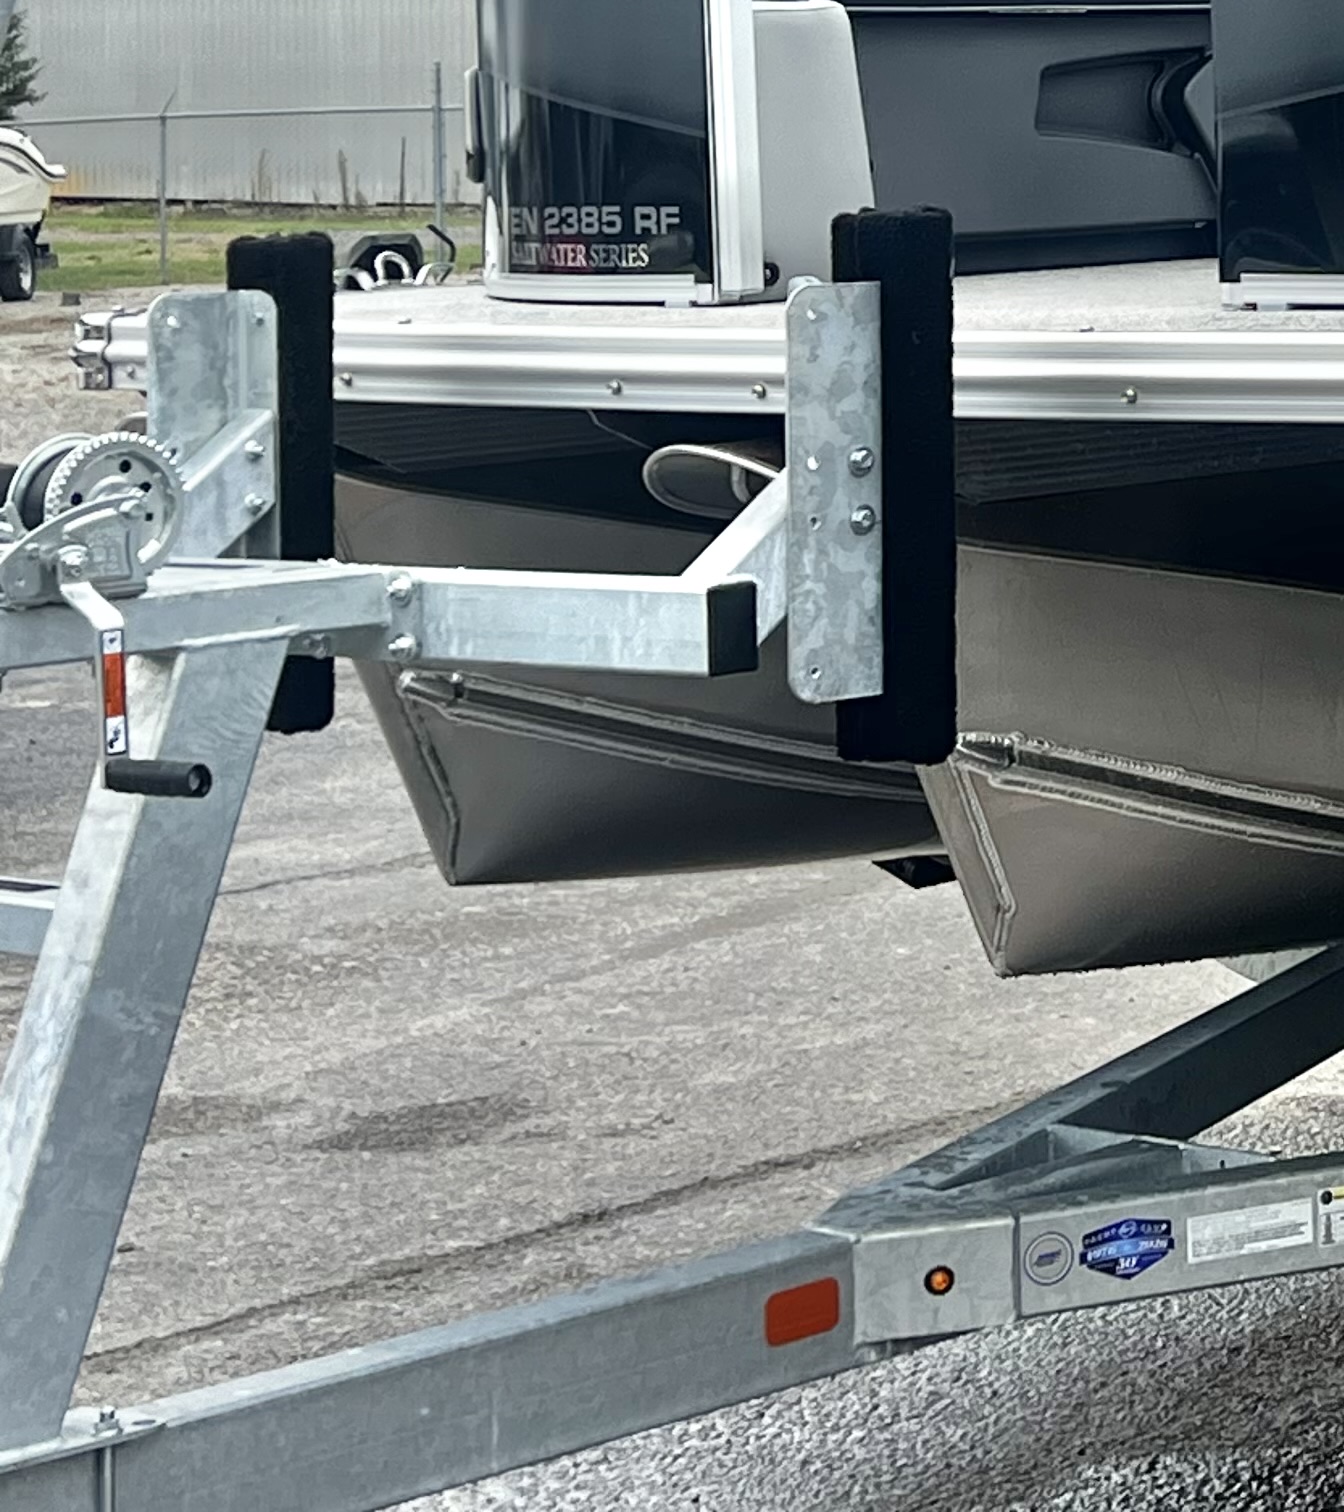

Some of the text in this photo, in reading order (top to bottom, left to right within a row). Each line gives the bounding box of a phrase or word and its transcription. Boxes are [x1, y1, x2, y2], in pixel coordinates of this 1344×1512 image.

[543, 205, 623, 236] 2385
[633, 205, 682, 236] RF
[588, 242, 651, 268] SERIES
